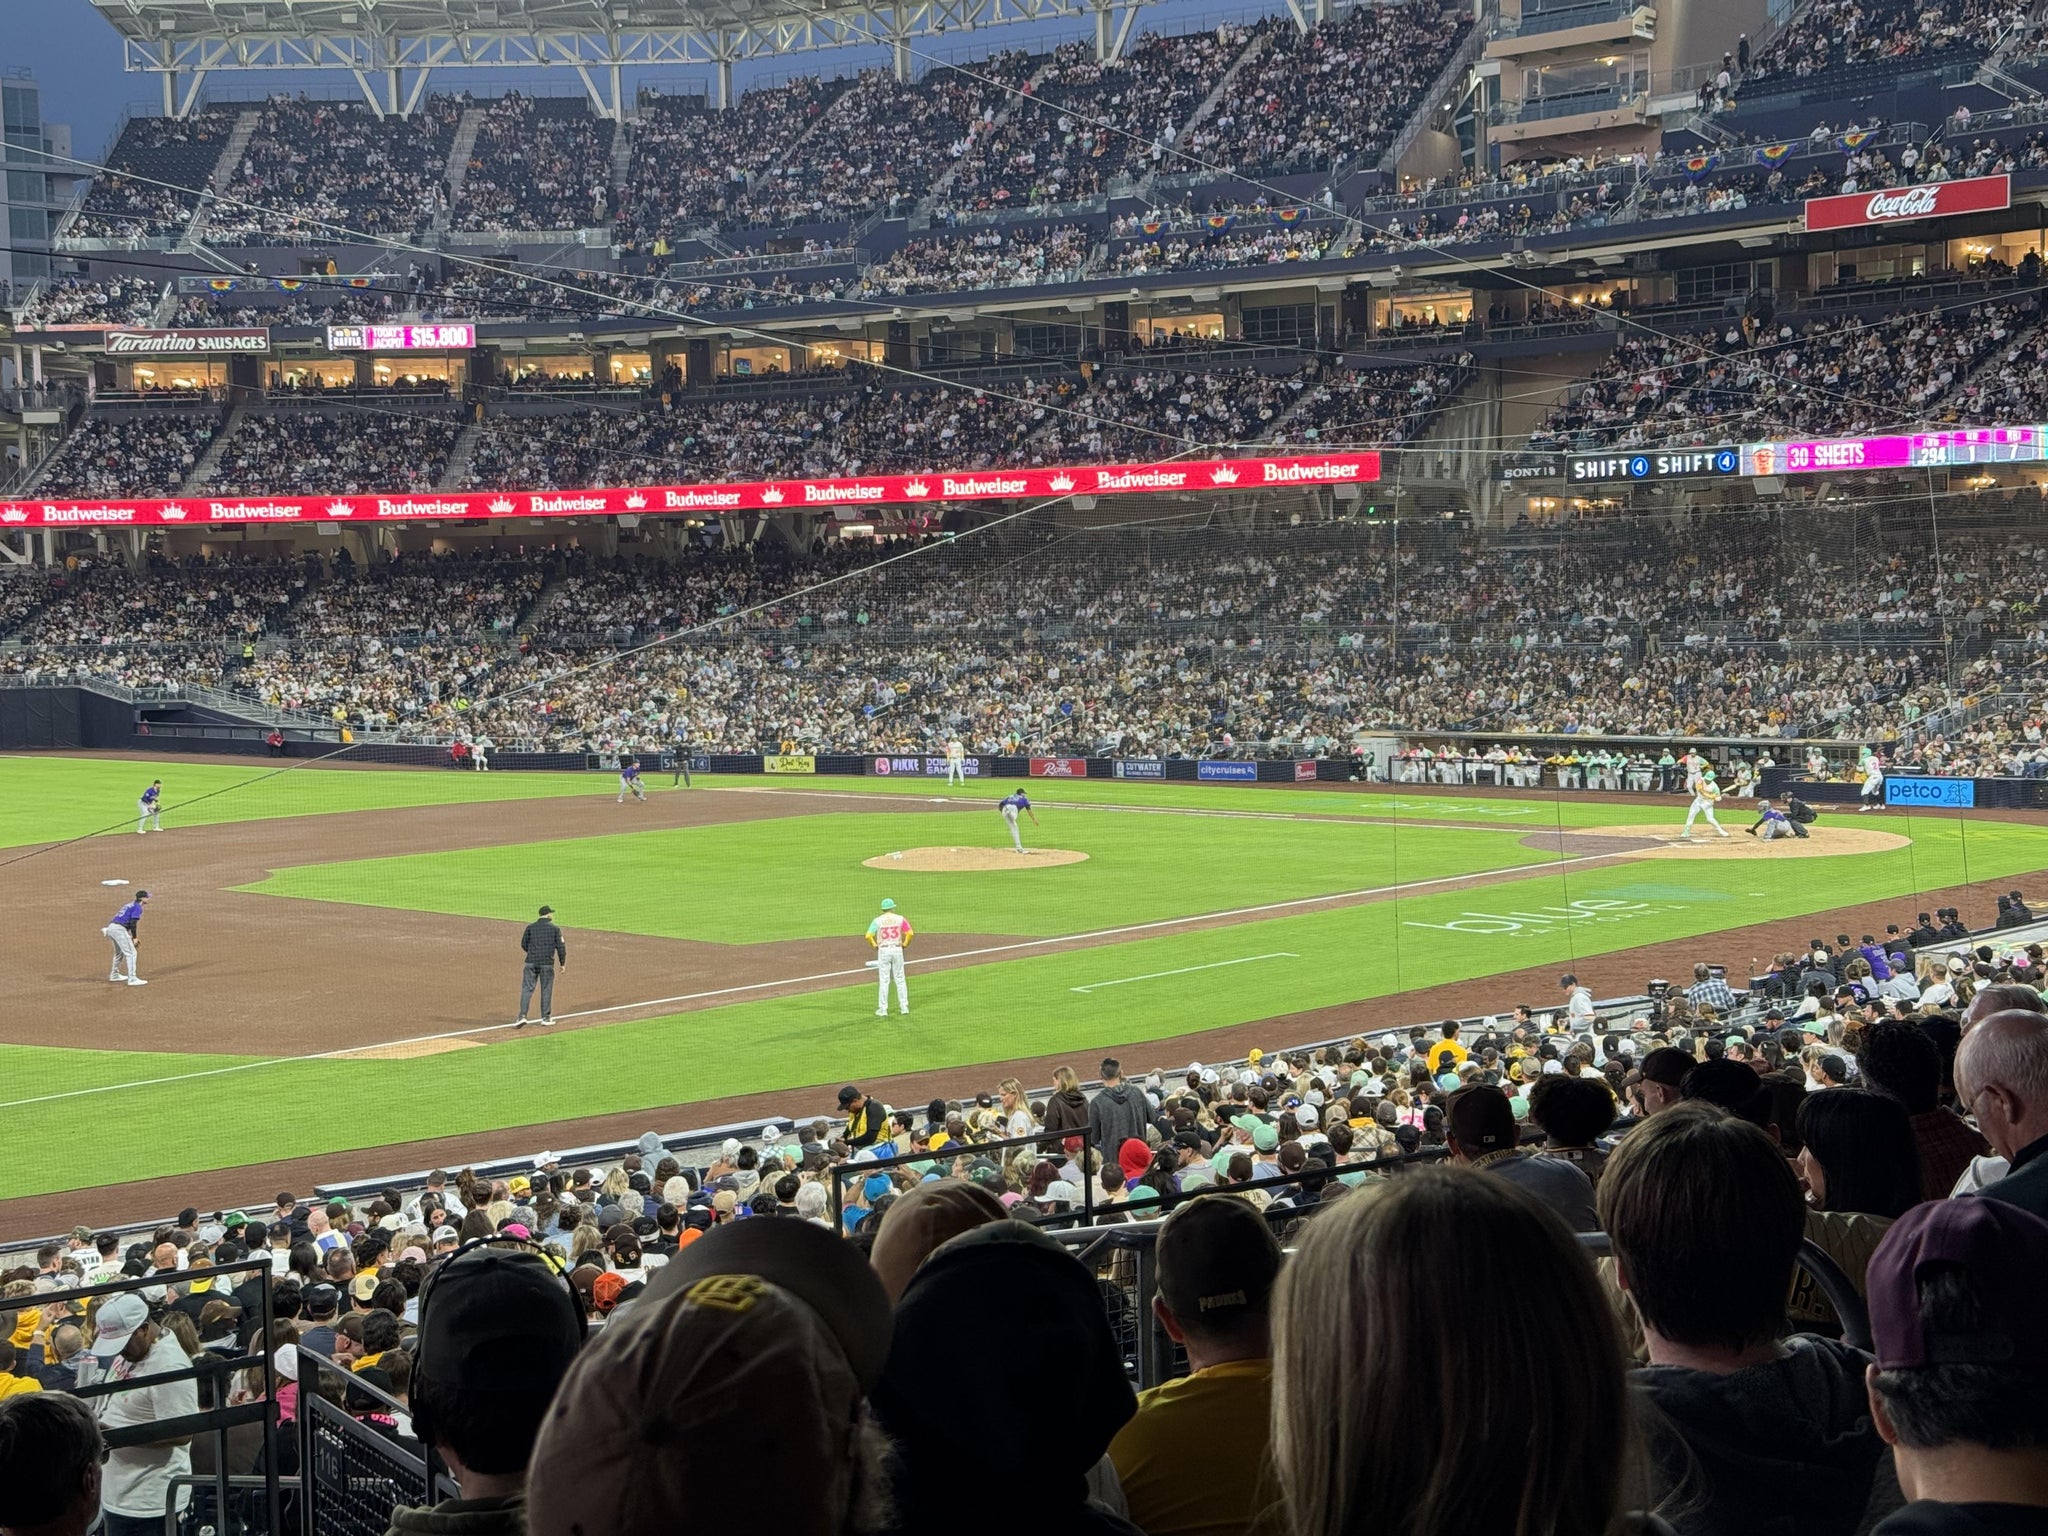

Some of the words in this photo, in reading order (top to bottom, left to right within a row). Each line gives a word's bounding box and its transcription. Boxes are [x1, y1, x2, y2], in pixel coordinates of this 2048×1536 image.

[108, 332, 196, 351] Tarantino
[198, 336, 267, 350] SAUSAGES
[333, 336, 362, 347] RAFFLE
[411, 326, 468, 347] $15,800
[1790, 447, 1809, 468] 30
[1814, 442, 1865, 466] SHEETS
[1917, 446, 1947, 465] .294
[1967, 445, 1976, 463] 1
[2008, 444, 2018, 460] 7
[1503, 467, 1542, 478] SONY
[1574, 459, 1630, 479] SHIFT
[1657, 453, 1716, 474] SHIFT
[43, 505, 136, 521] Budweiser
[209, 502, 303, 519] Budweiser
[378, 499, 469, 516] Budweiser
[530, 496, 607, 512] Budweiser
[665, 490, 741, 507] Budweiser
[804, 484, 885, 502] Budweiser
[943, 477, 1027, 496] Budweiser
[1096, 470, 1187, 489] Budweiser
[1263, 460, 1359, 482] Budweiser
[1126, 762, 1161, 772] CUTWATER
[1200, 765, 1246, 776] citycruises
[1889, 781, 1942, 801] petco
[1402, 899, 1649, 934] blue
[880, 926, 900, 940] 33
[321, 1448, 339, 1480] 116
